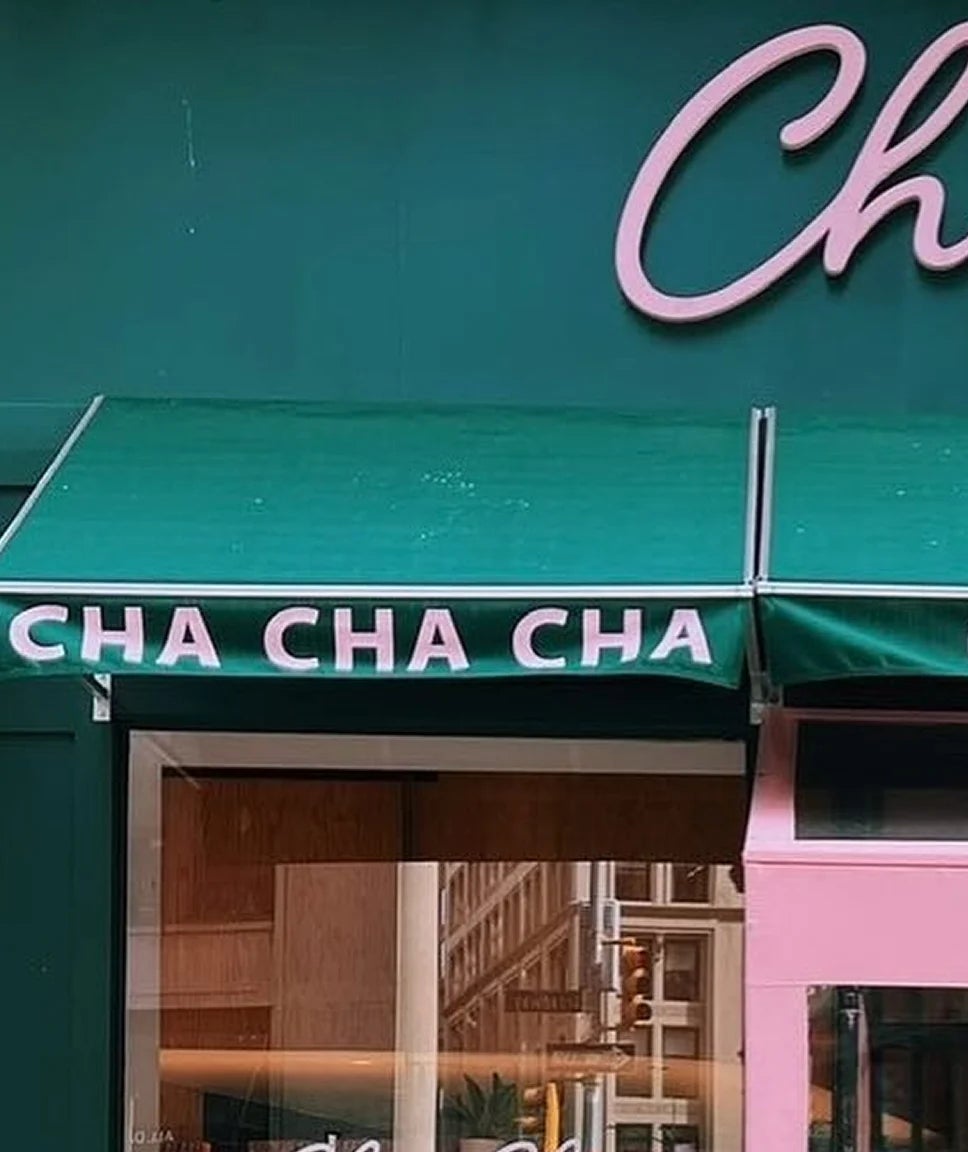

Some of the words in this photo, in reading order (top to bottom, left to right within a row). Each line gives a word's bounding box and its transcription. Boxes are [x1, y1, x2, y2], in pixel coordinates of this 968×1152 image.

[9, 604, 219, 668] CHA
[263, 606, 468, 672] CHA
[512, 607, 712, 669] CHA
